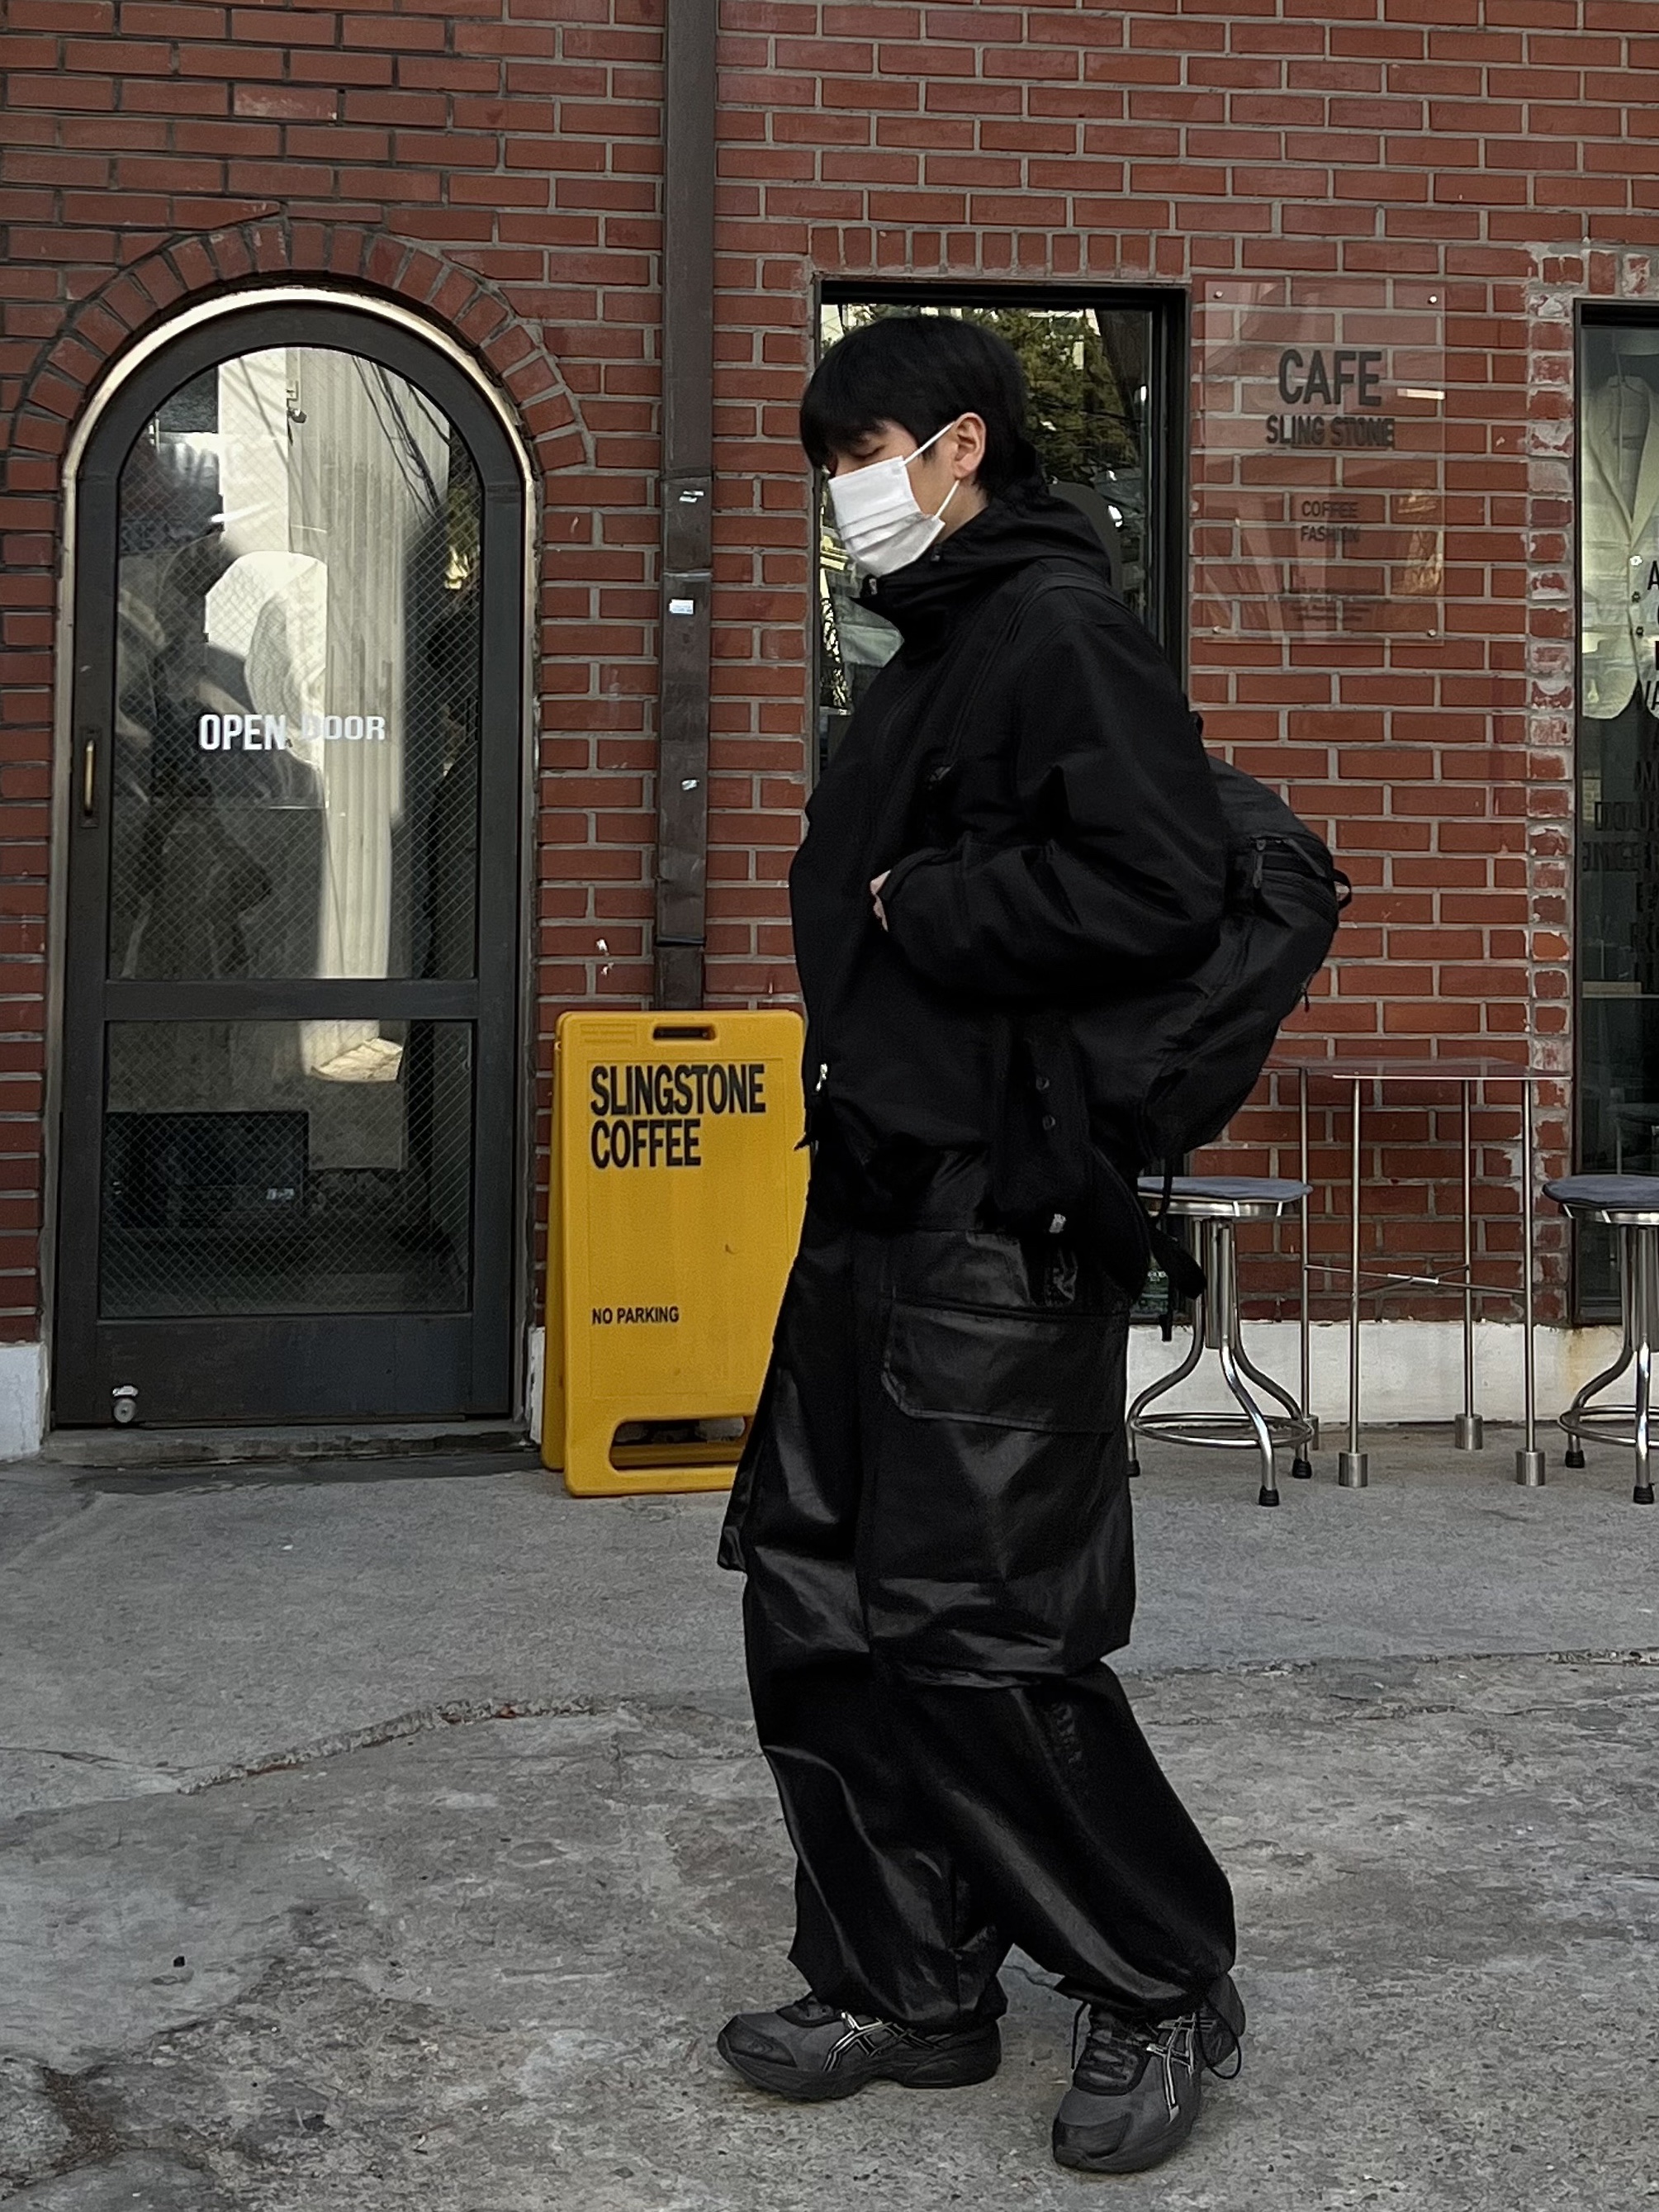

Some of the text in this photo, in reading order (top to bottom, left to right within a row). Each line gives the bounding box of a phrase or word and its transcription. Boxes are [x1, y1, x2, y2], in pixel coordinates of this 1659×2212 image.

[1279, 349, 1382, 406] CAFE
[1266, 415, 1396, 447] SLING STONE
[1301, 501, 1358, 518] COFFEE
[199, 714, 386, 750] OPEN DOOR
[590, 1064, 766, 1115] SLINGSTONE
[591, 1118, 701, 1169] COFFEE
[592, 1306, 680, 1325] NO PARKING
